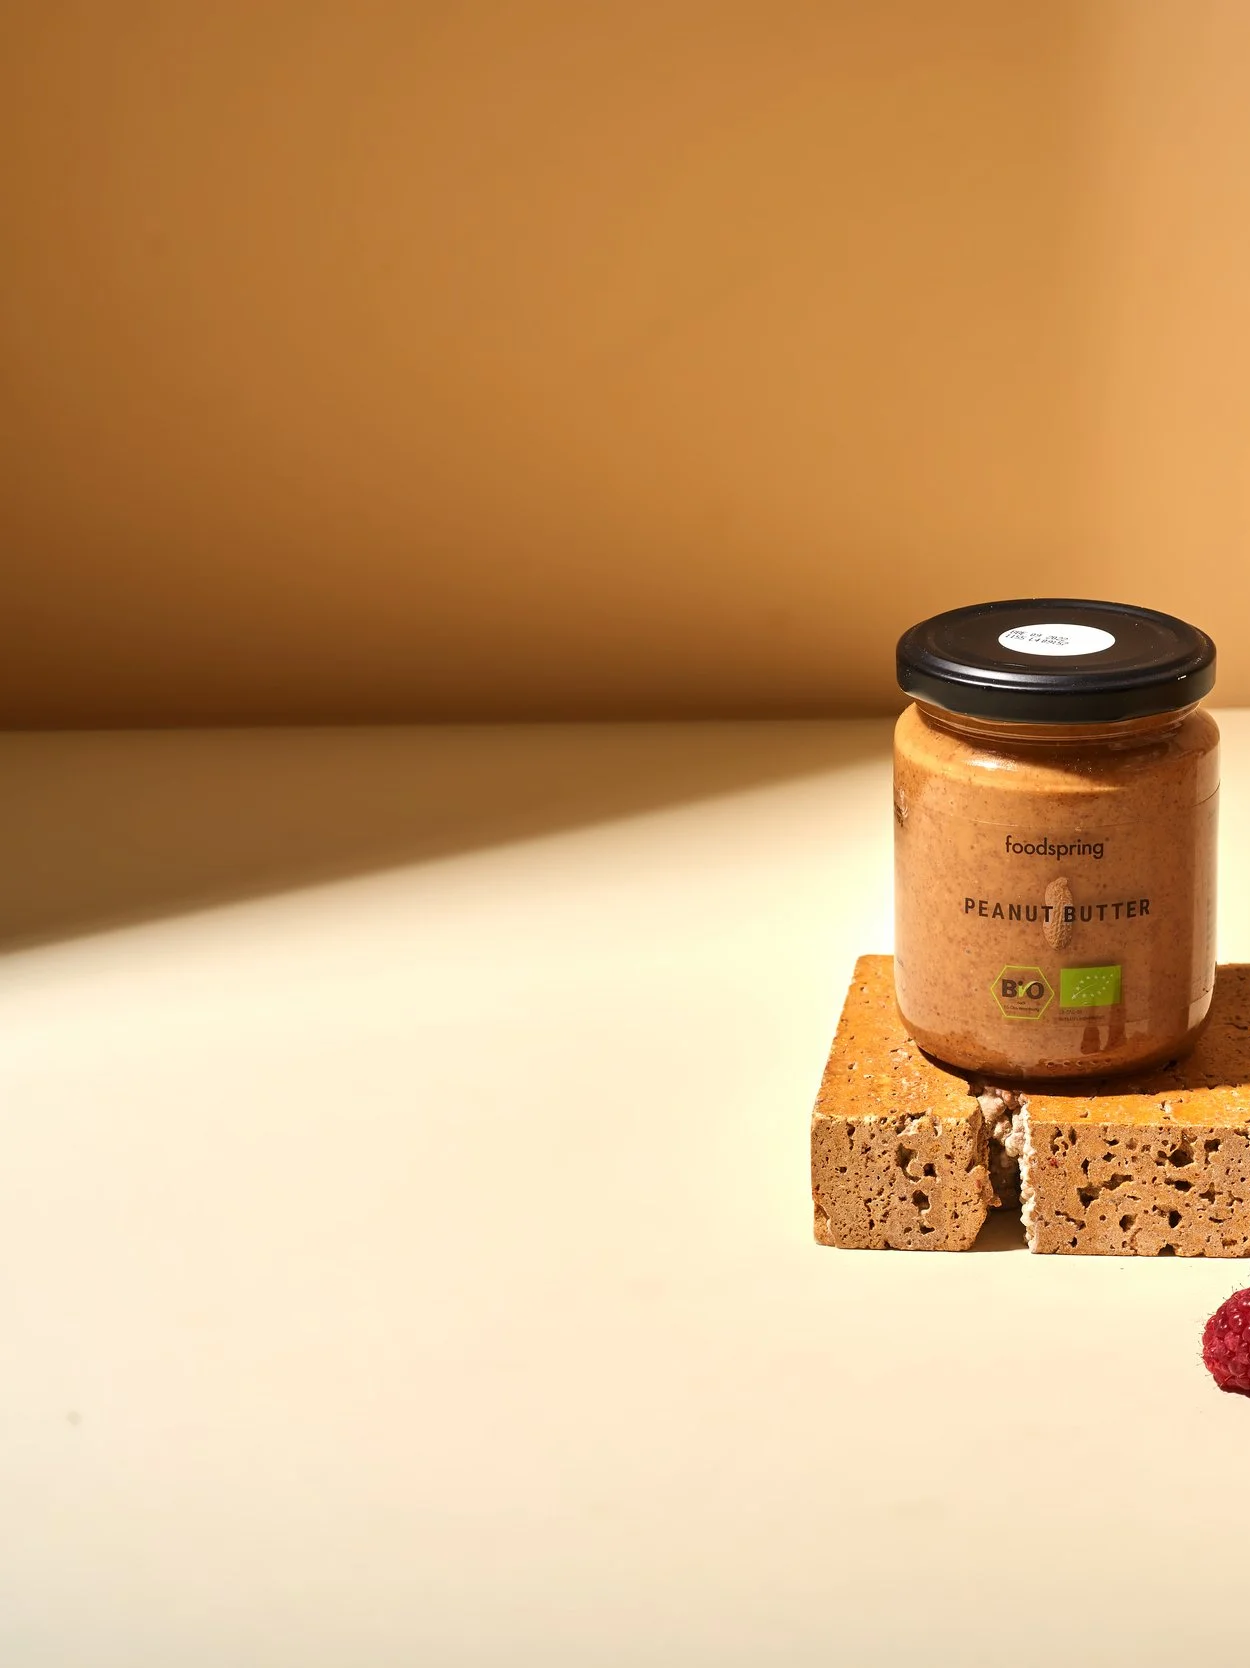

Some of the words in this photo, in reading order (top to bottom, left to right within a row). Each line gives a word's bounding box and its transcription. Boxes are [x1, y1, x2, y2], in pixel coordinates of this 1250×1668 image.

[1005, 835, 1104, 861] foodspring
[964, 897, 1054, 923] PEANUT
[1064, 899, 1151, 923] BUTTER
